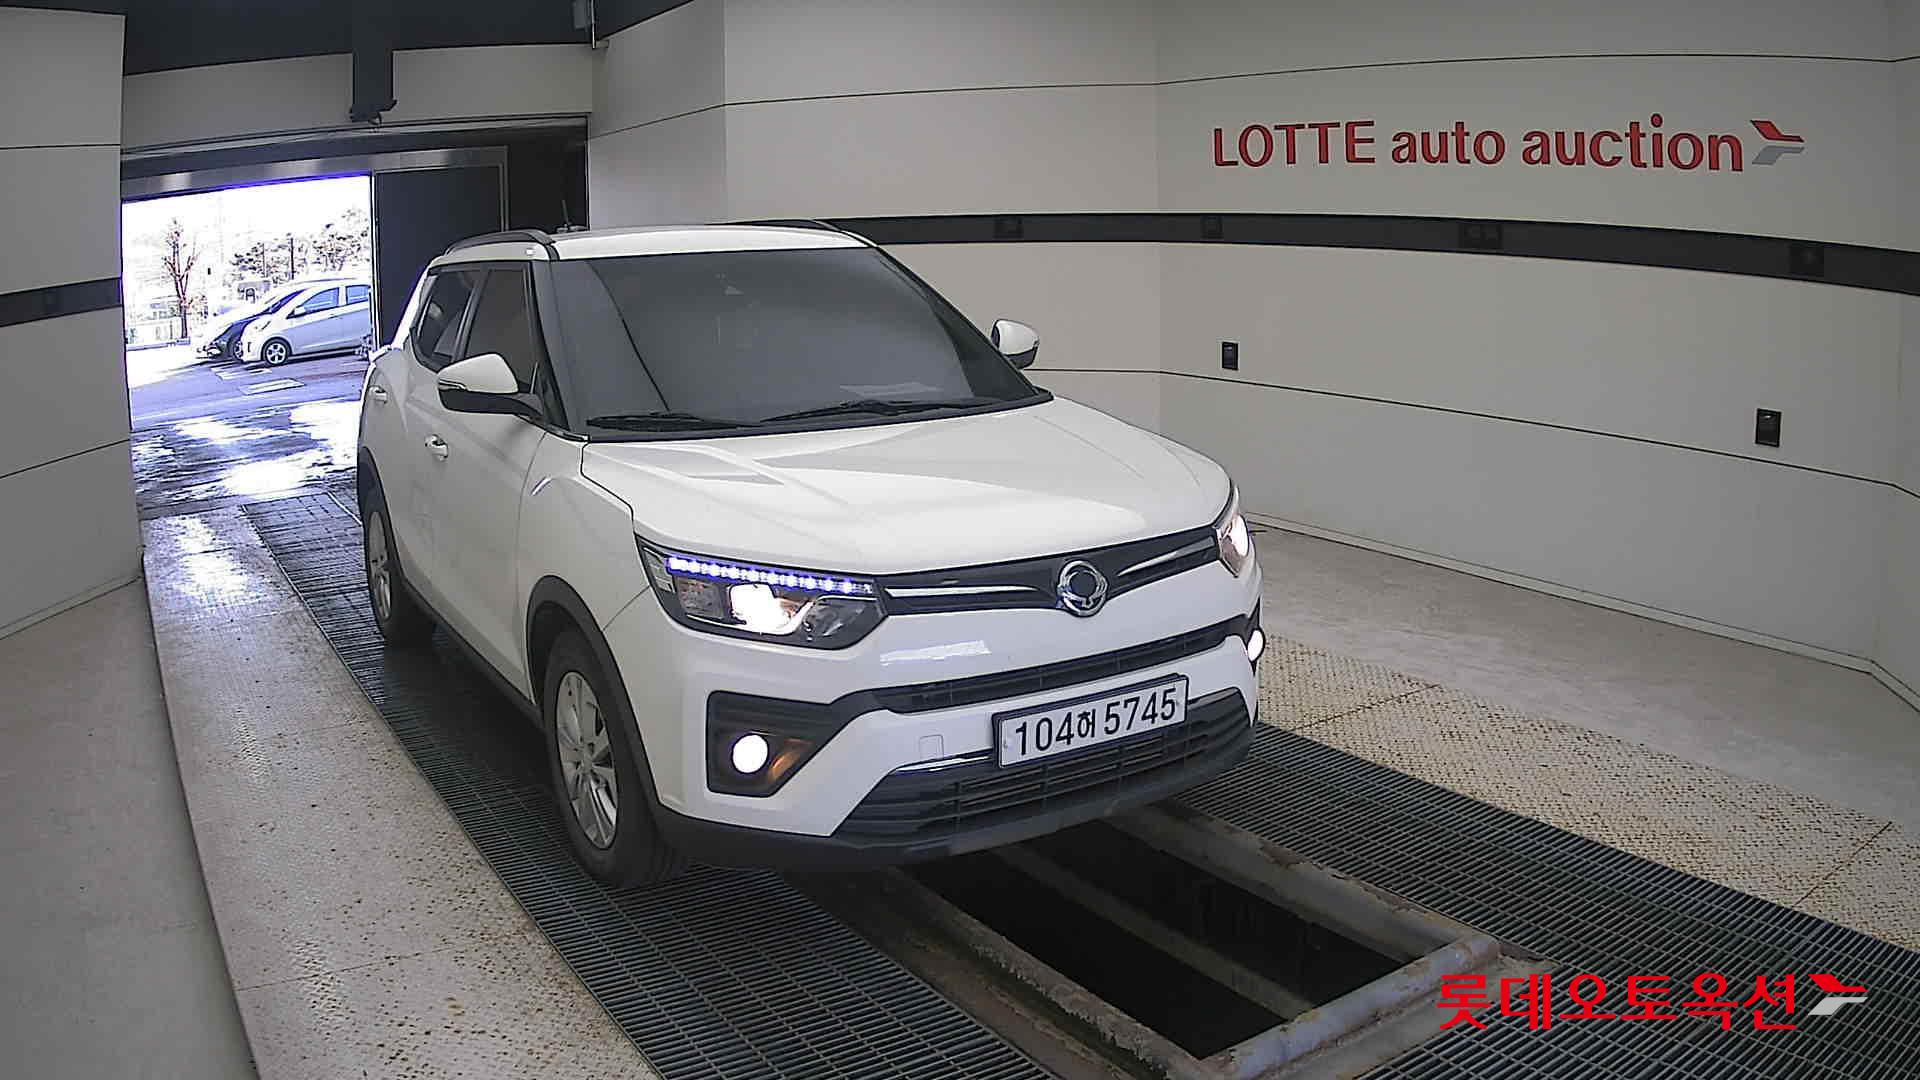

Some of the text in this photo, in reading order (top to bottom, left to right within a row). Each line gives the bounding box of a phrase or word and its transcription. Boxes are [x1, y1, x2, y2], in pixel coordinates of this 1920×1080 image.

[1213, 112, 1744, 172] LOTTE auto auction
[1014, 687, 1177, 756] 104허 5745
